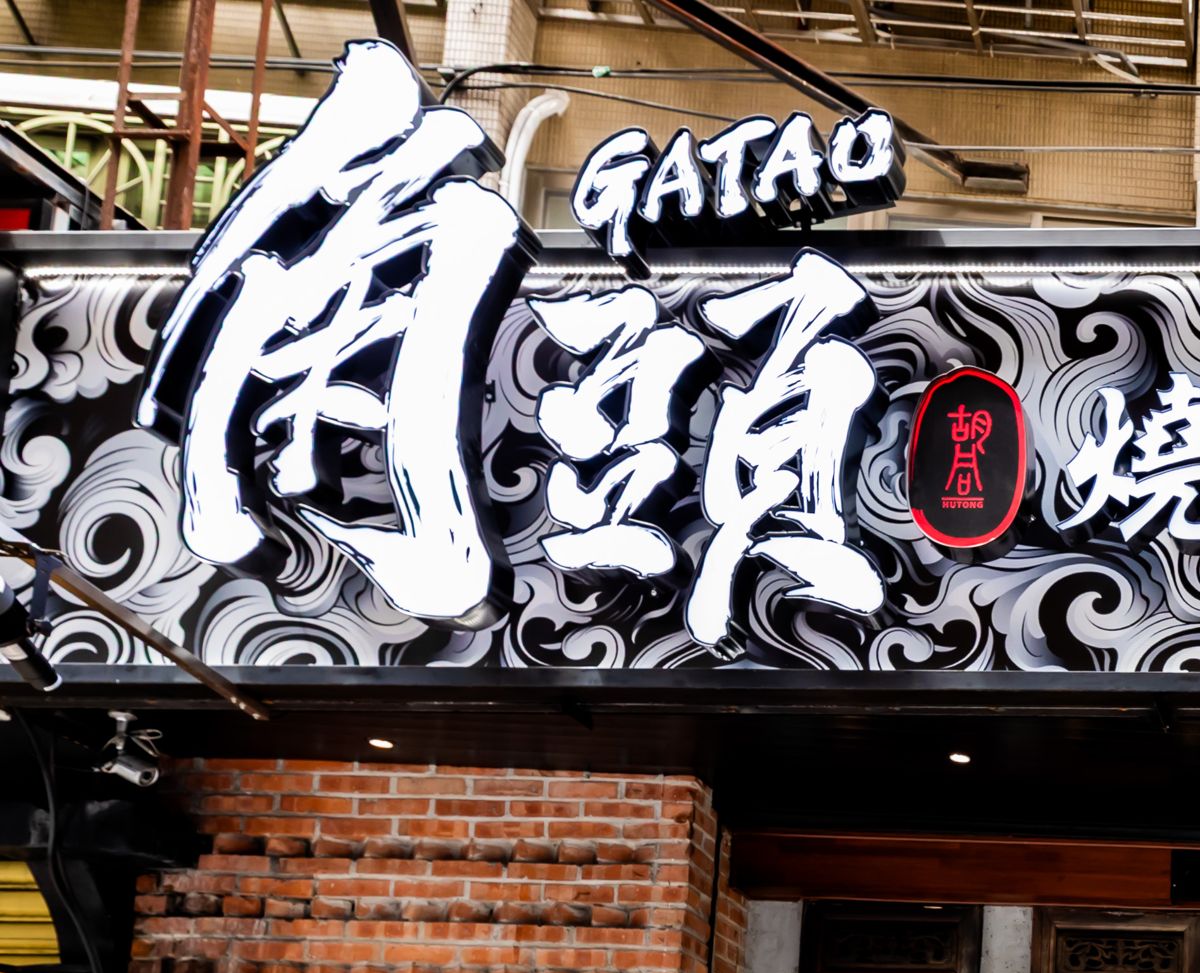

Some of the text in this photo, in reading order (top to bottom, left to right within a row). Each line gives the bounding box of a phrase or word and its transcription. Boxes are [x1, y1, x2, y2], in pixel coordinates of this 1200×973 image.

[573, 108, 896, 257] GATAO
[137, 38, 886, 646] 角頭
[942, 501, 984, 509] HUTONG
